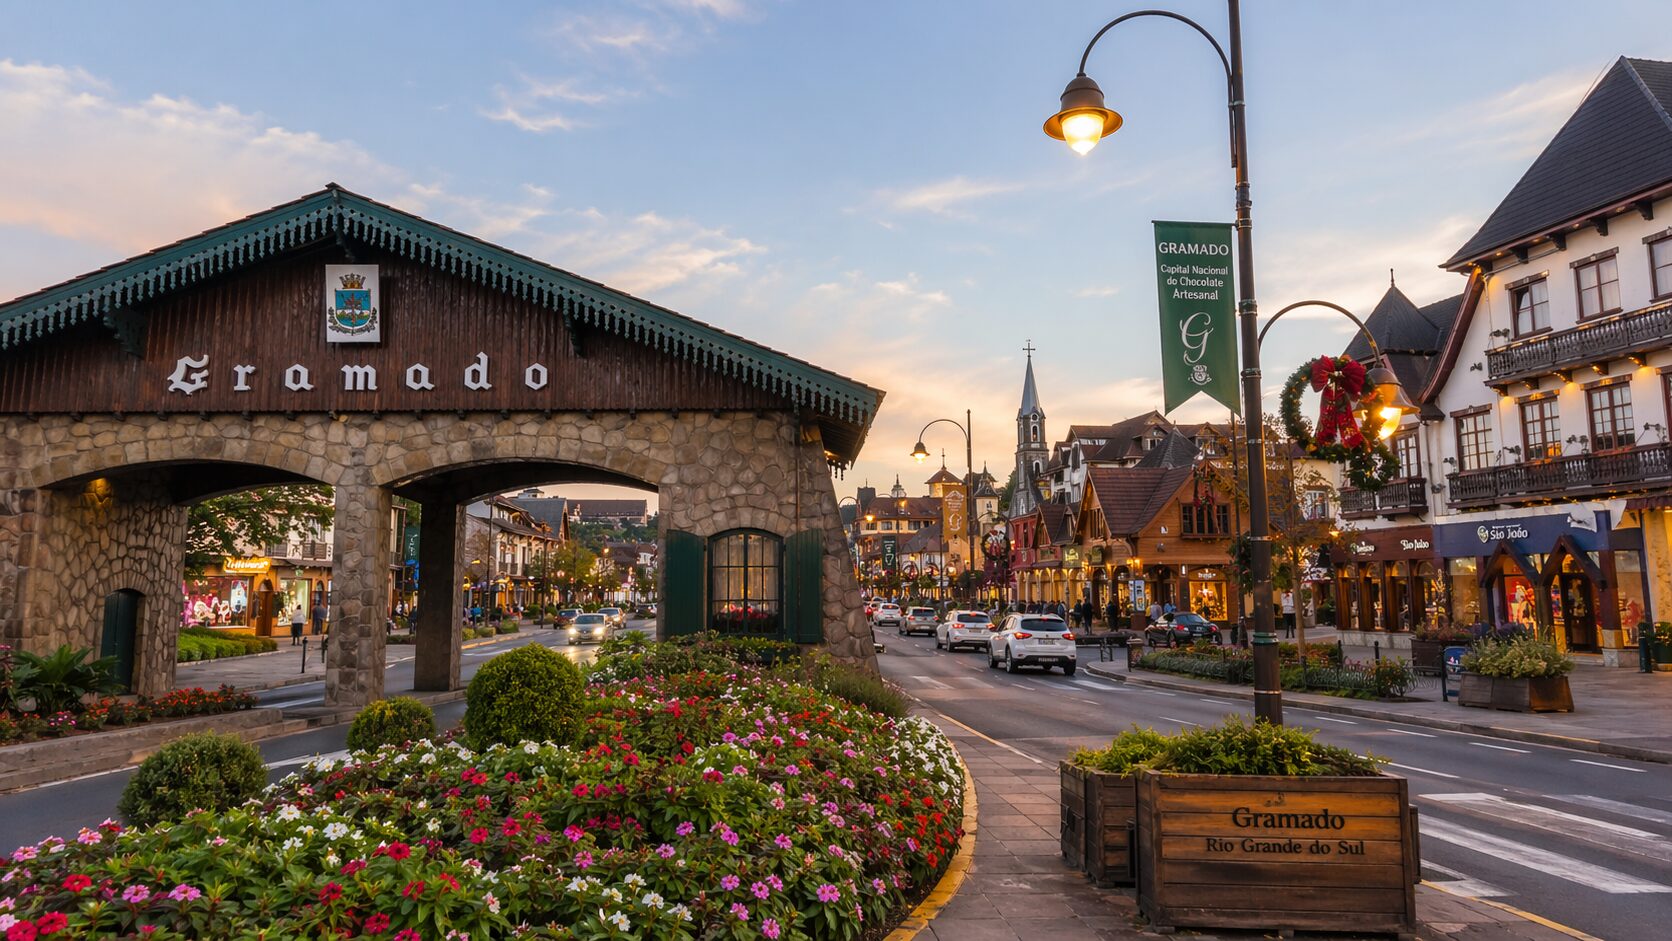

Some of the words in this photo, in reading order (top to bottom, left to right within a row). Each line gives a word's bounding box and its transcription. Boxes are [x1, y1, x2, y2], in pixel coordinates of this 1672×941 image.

[1158, 242, 1229, 256] GRAMADO
[1160, 264, 1190, 275] Capital
[1192, 265, 1228, 275] Nacional
[1166, 276, 1178, 286] do
[1179, 277, 1224, 287] Chocolate
[1172, 288, 1219, 300] Artesanal
[166, 351, 549, 396] Gramado
[1232, 806, 1346, 830] Gramado
[1205, 837, 1235, 853] Rio
[1241, 837, 1303, 855] Grande
[1309, 839, 1332, 855] do
[1338, 840, 1366, 856] Sul
